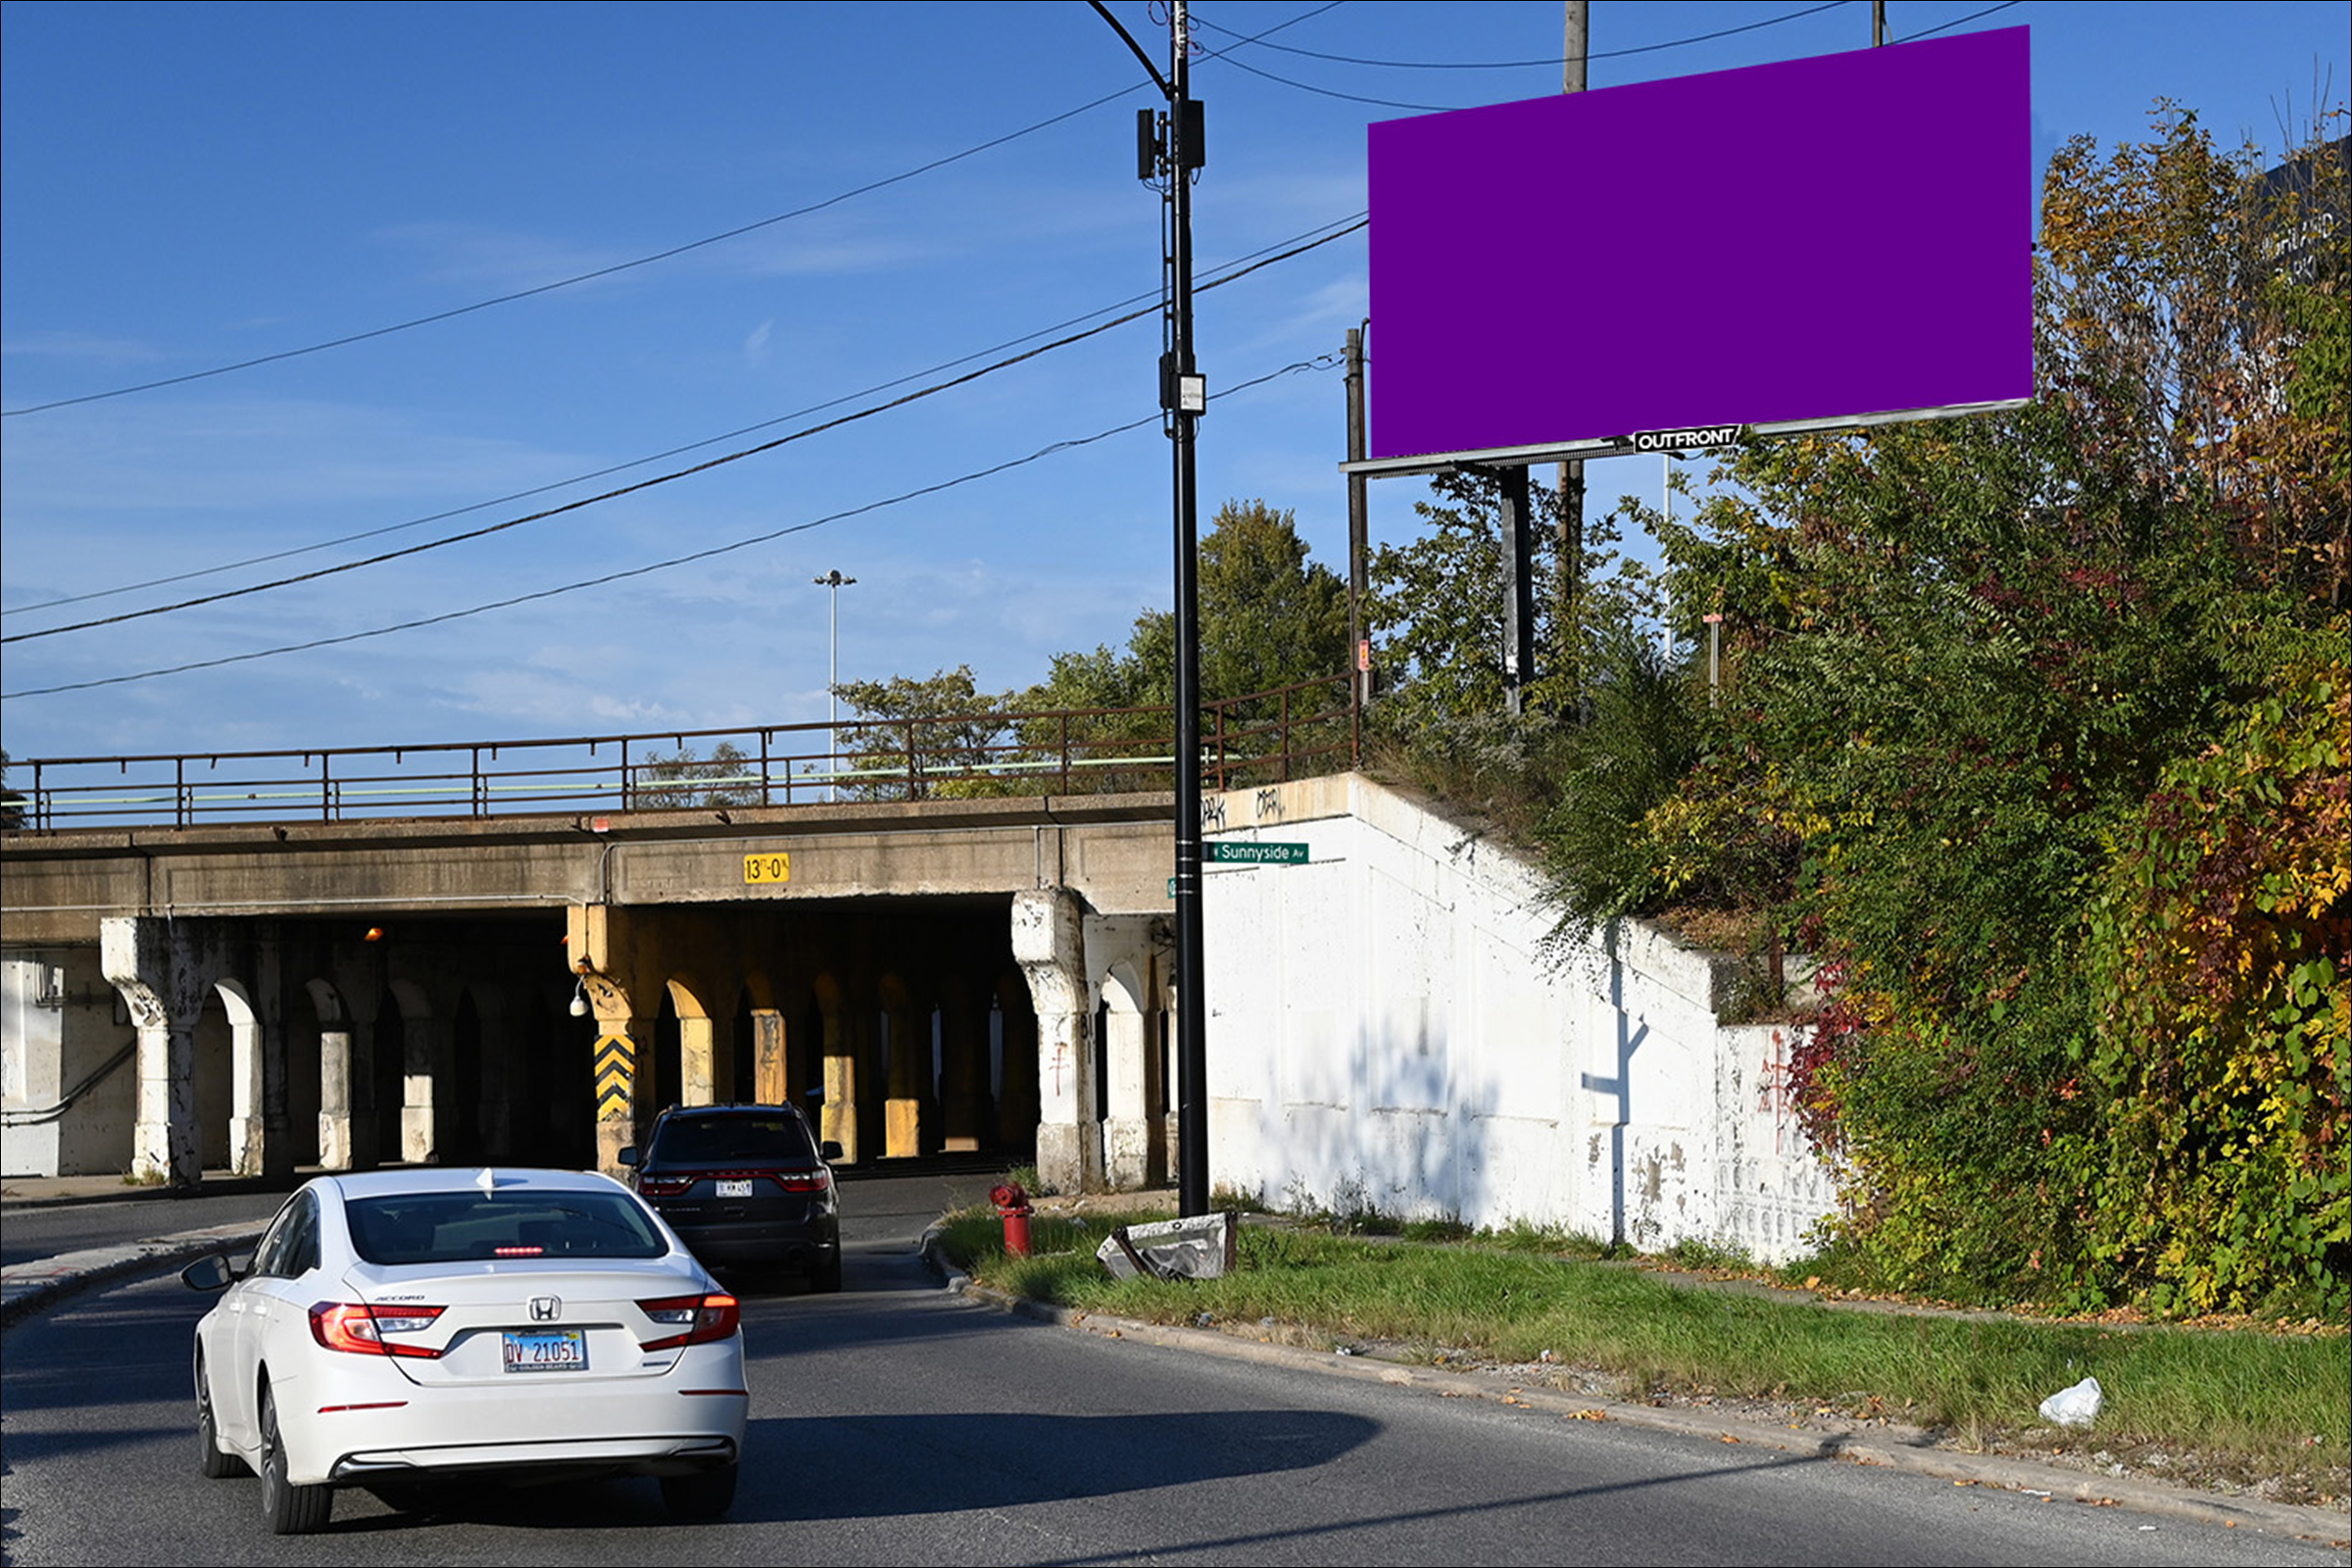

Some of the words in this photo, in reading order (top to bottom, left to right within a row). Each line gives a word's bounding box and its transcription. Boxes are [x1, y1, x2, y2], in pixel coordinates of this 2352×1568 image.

[1639, 428, 1735, 450] OUTFRONT
[1221, 844, 1290, 862] Sunnyside
[1292, 848, 1304, 858] Av
[505, 1343, 523, 1363] DV
[533, 1341, 579, 1362] 21051
